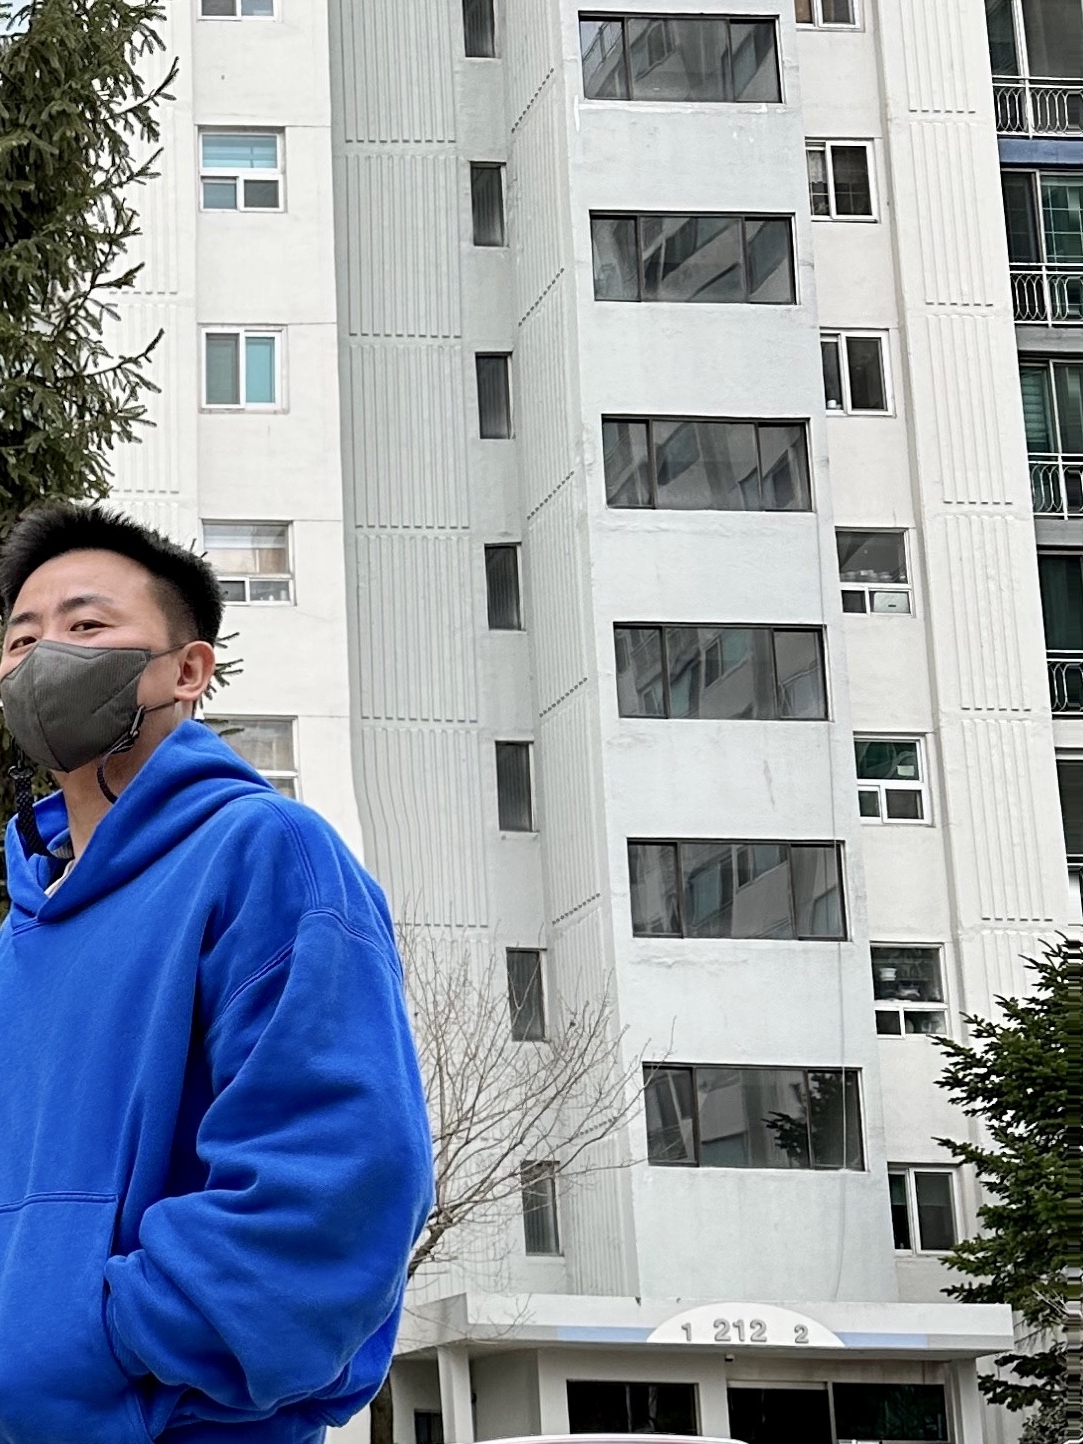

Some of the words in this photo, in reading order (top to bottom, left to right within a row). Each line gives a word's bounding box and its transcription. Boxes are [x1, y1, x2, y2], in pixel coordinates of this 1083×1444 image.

[681, 1322, 692, 1342] 1
[713, 1318, 767, 1342] 212
[794, 1324, 809, 1344] 2
